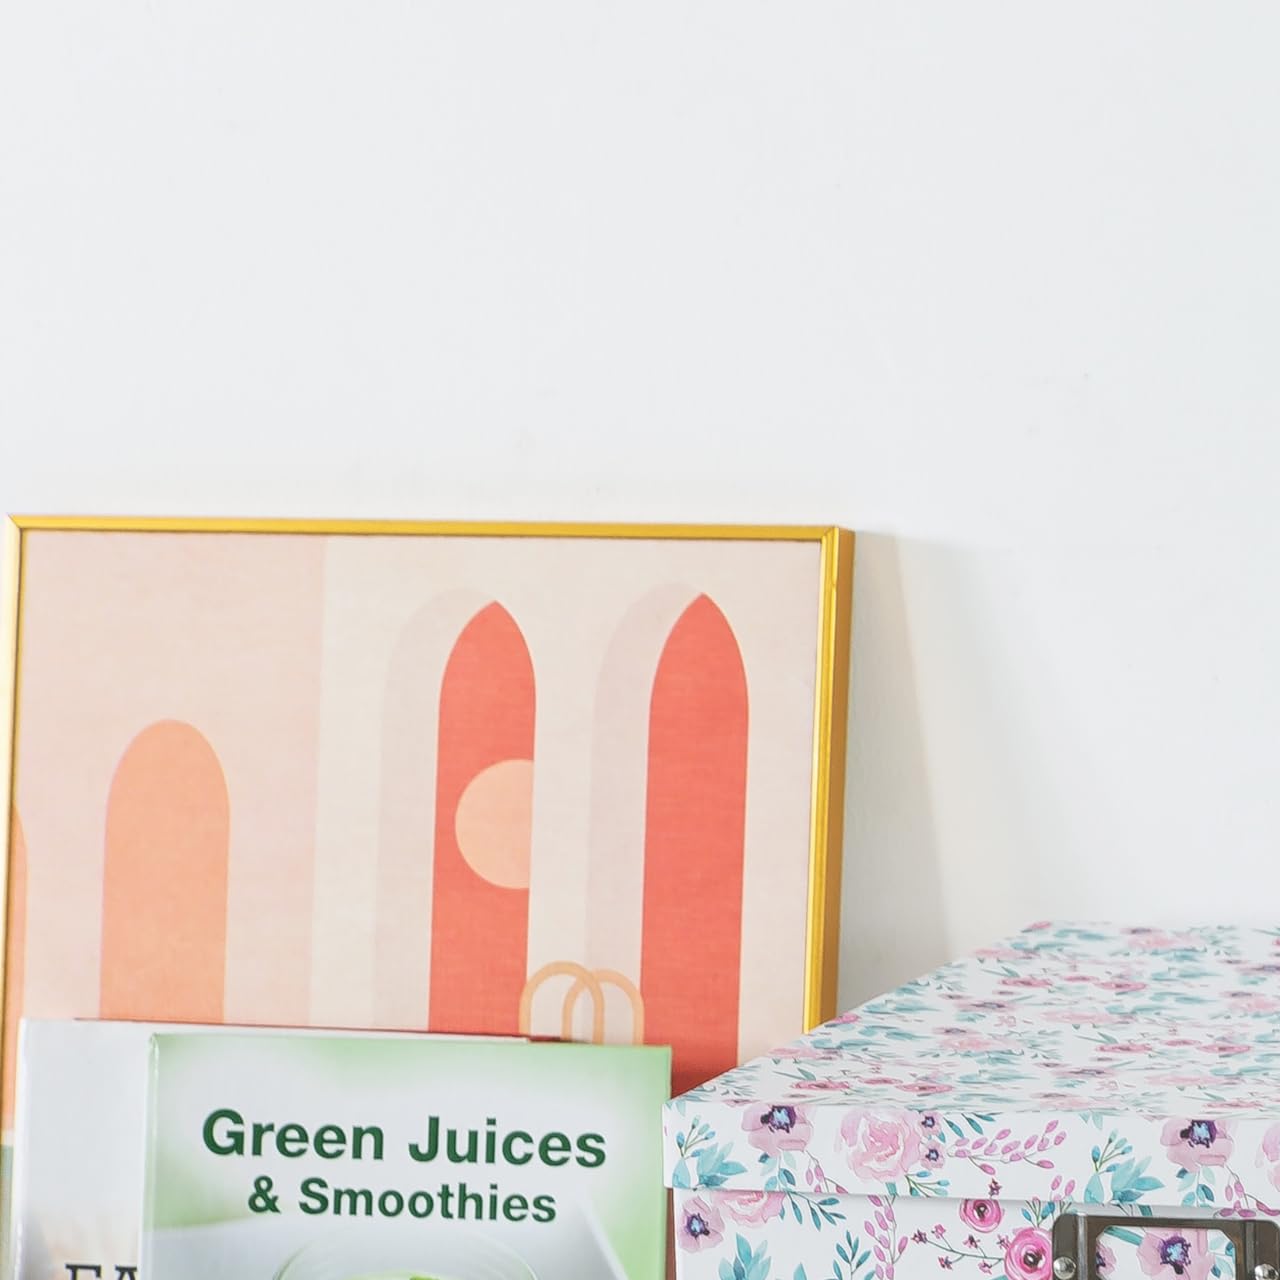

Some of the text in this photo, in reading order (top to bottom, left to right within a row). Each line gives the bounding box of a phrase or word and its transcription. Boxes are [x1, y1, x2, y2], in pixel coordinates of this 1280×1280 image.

[202, 1108, 606, 1169] Green Juices
[247, 1175, 557, 1224] & Smoothies
